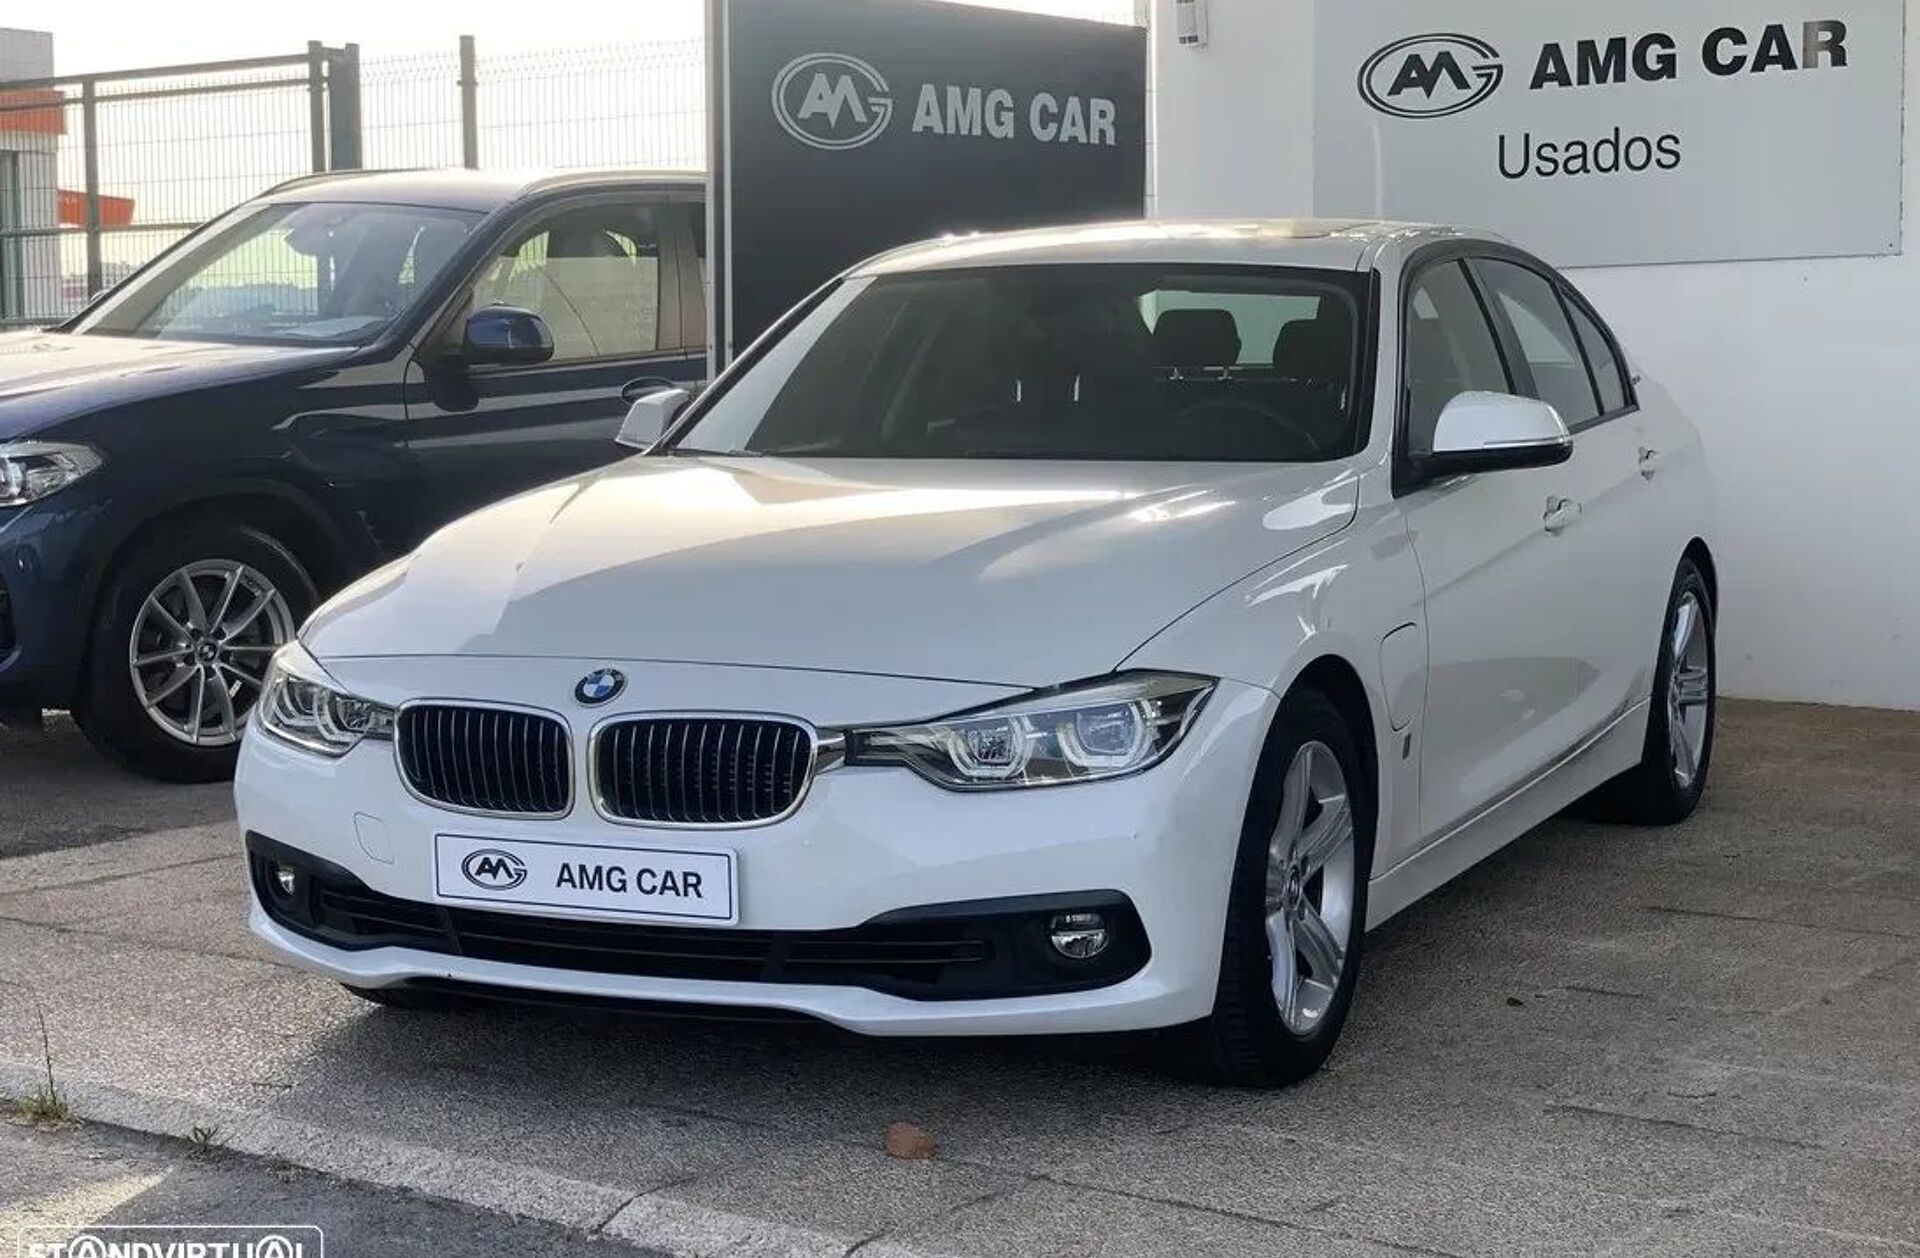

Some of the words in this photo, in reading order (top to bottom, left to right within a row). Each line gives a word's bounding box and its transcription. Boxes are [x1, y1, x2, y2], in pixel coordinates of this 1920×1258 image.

[1530, 34, 1677, 90] AMG
[1702, 20, 1848, 76] CAR
[912, 84, 1014, 139] AMG
[1029, 93, 1116, 146] CAR
[1499, 127, 1681, 179] Usados
[555, 862, 627, 893] AMG
[636, 868, 704, 898] CAR
